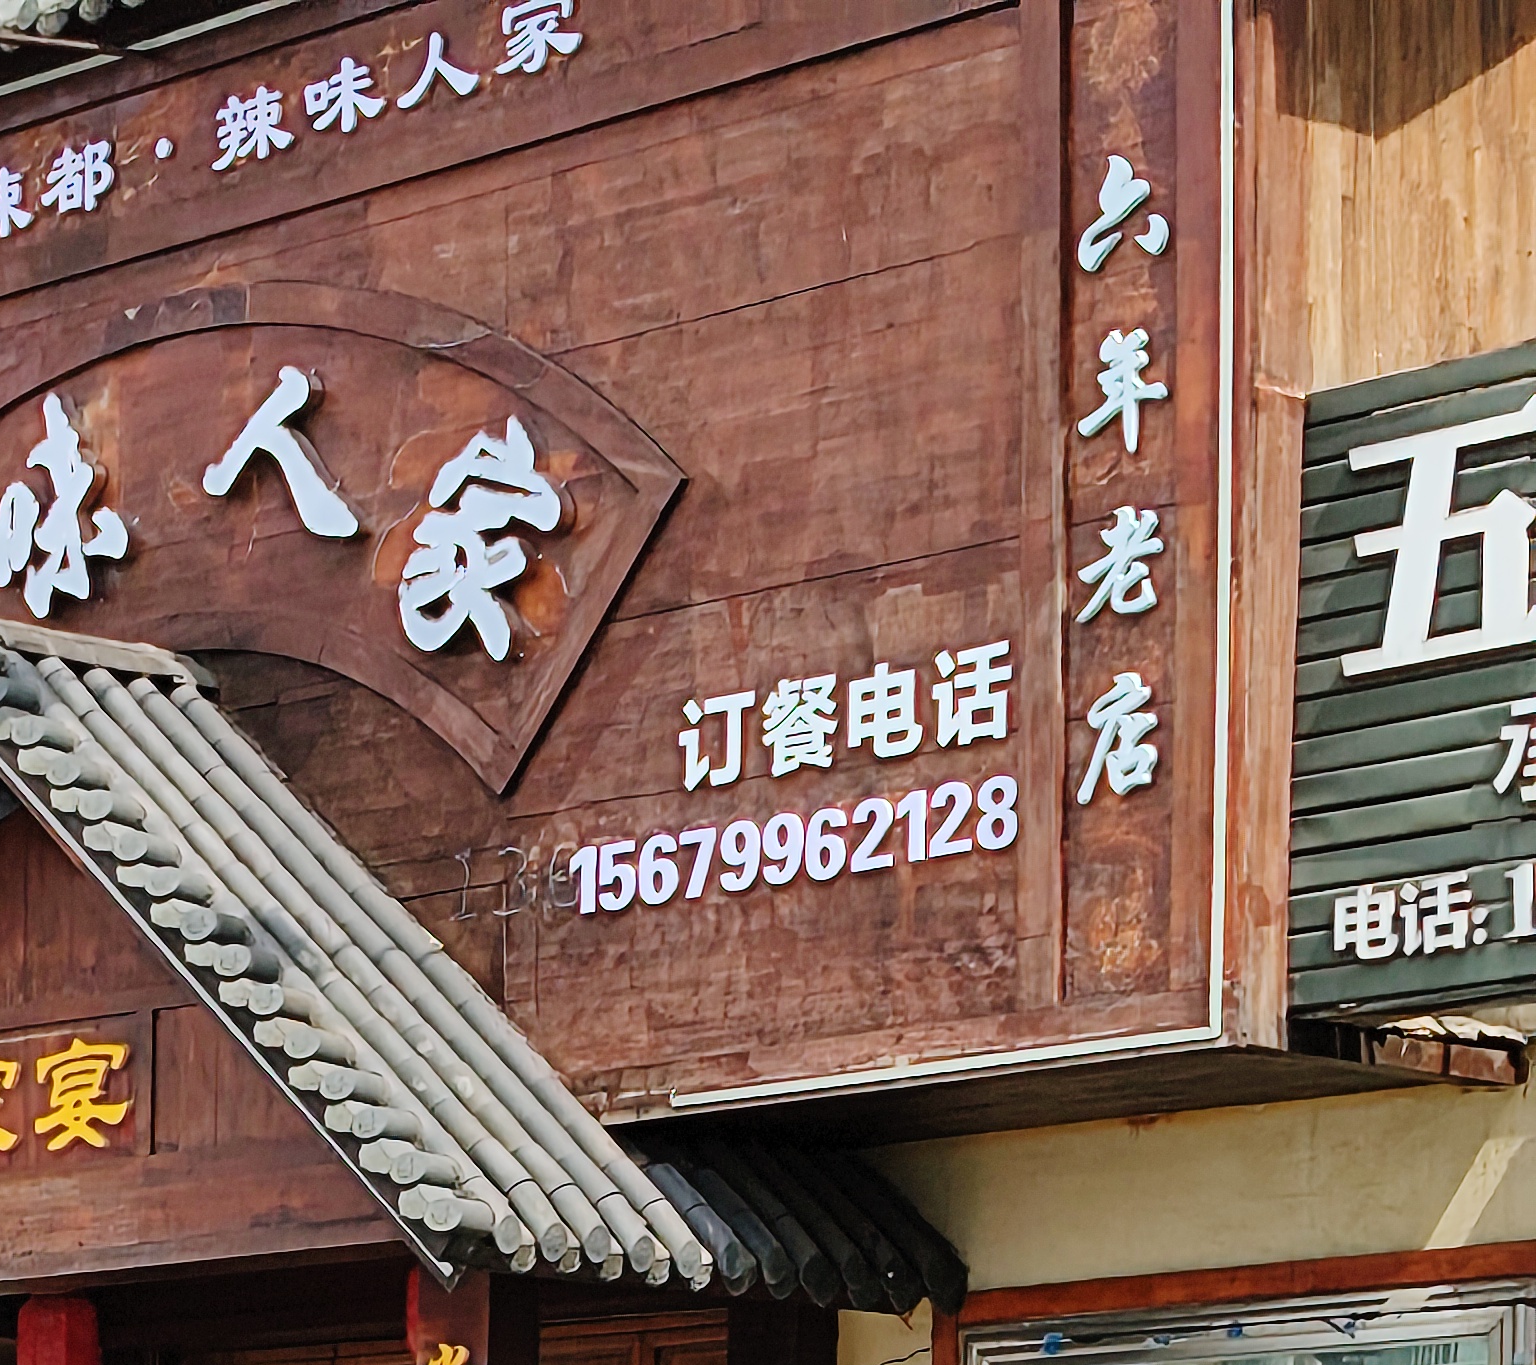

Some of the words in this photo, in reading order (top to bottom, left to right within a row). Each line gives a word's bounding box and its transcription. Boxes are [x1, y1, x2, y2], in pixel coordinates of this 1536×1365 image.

[1075, 154, 1170, 805] 六年老店
[1340, 392, 1536, 677] 五
[678, 640, 1014, 793] 订餐电话
[569, 775, 1018, 915] 15679962128
